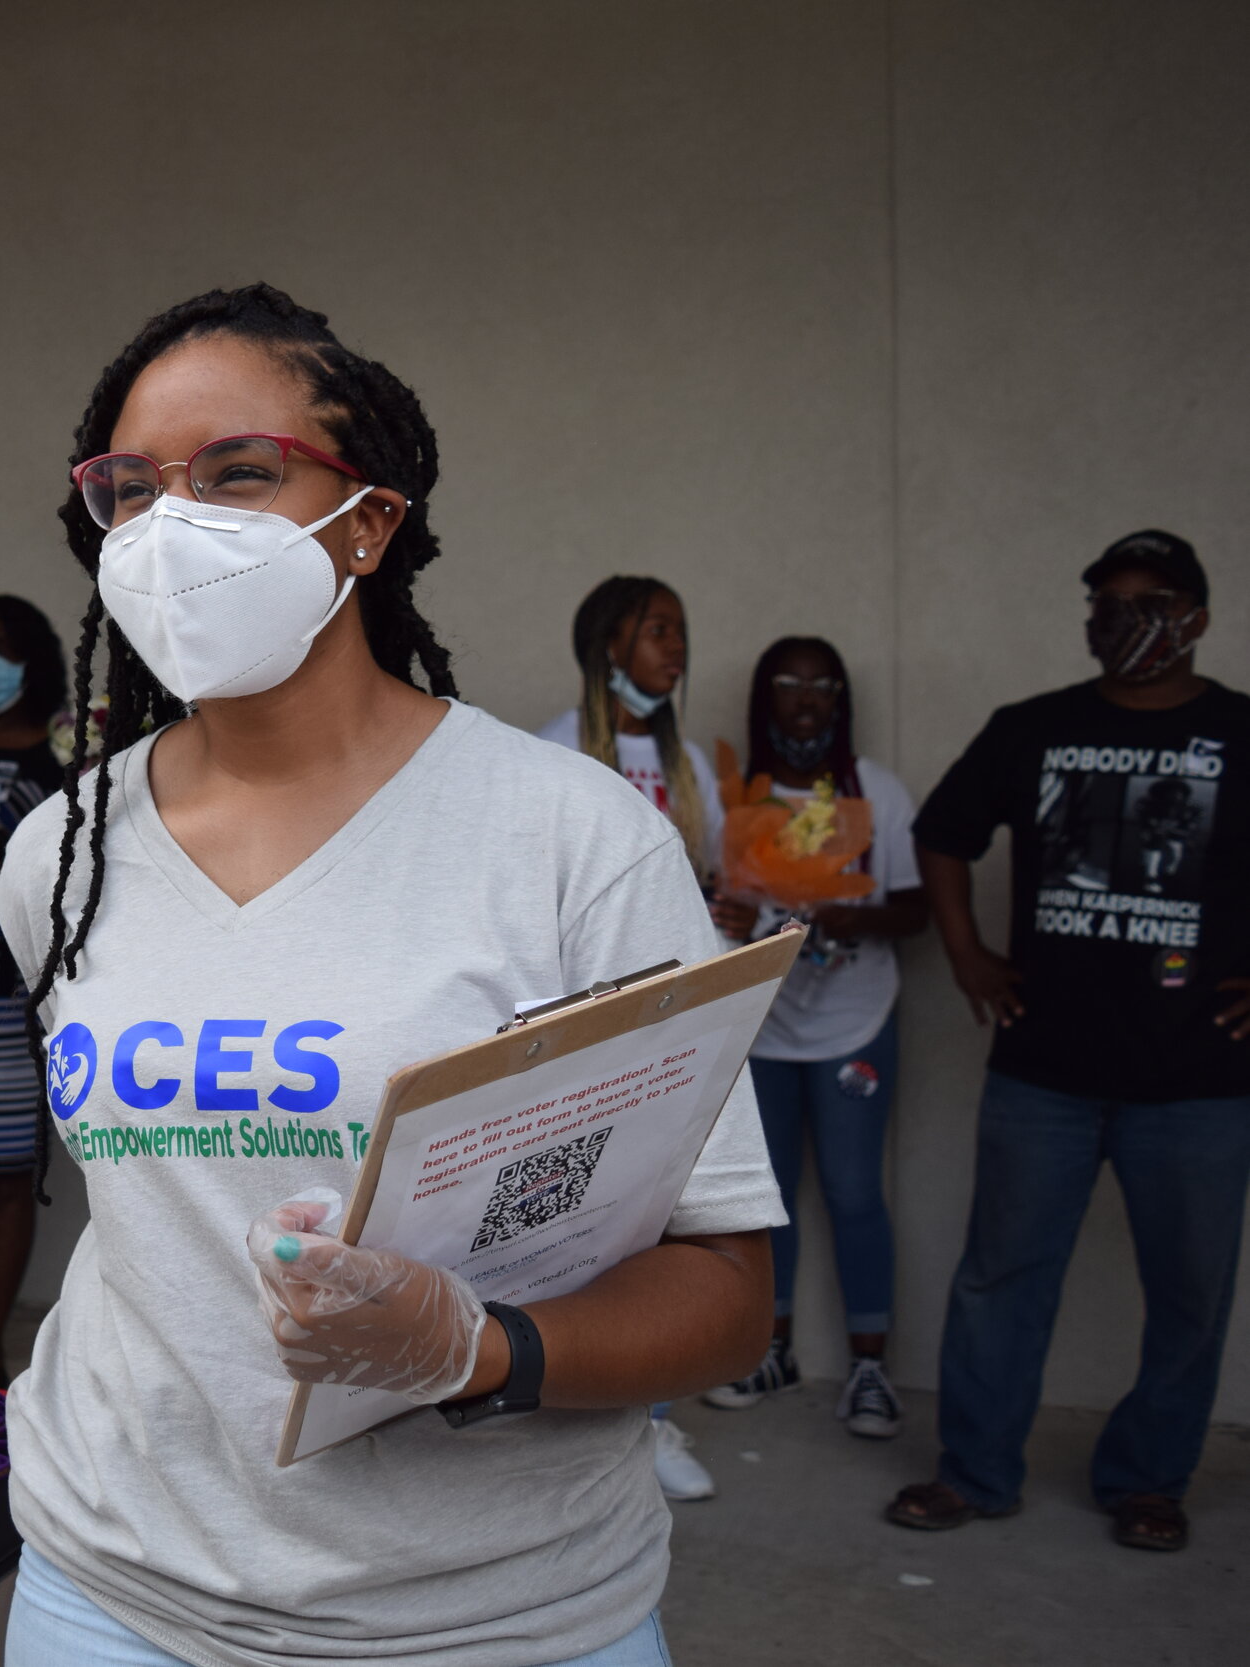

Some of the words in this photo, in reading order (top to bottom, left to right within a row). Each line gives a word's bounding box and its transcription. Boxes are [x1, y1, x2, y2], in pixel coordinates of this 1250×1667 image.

[1043, 746, 1155, 773] NOBODY
[1157, 750, 1223, 779] DID
[1036, 908, 1094, 936] TOOK
[1099, 914, 1120, 939] A
[1126, 917, 1199, 947] KNEE
[112, 1019, 345, 1113] CES
[423, 1151, 458, 1169] here
[462, 1143, 478, 1154] to
[482, 1131, 502, 1147] fill
[506, 1122, 532, 1137] out
[536, 1109, 571, 1128] form
[576, 1103, 592, 1113] to
[595, 1088, 630, 1107] have
[634, 1083, 643, 1091] a
[648, 1066, 686, 1086] voter
[428, 1128, 476, 1153] Hands
[481, 1116, 512, 1131] free
[517, 1099, 558, 1118] voter
[561, 1063, 655, 1104] registration!
[661, 1048, 697, 1067] Scan
[79, 1119, 236, 1165] Empowerment
[238, 1117, 344, 1160] Solutions
[417, 1146, 507, 1186] registration
[512, 1132, 548, 1151] card
[550, 1119, 584, 1137] sent
[587, 1097, 643, 1123] directly
[646, 1089, 660, 1100] to
[663, 1074, 696, 1095] your
[413, 1179, 463, 1201] house.
[470, 1263, 509, 1282] LEAGUE
[521, 1242, 558, 1261] WOMEN
[527, 1255, 598, 1289] vote411.org
